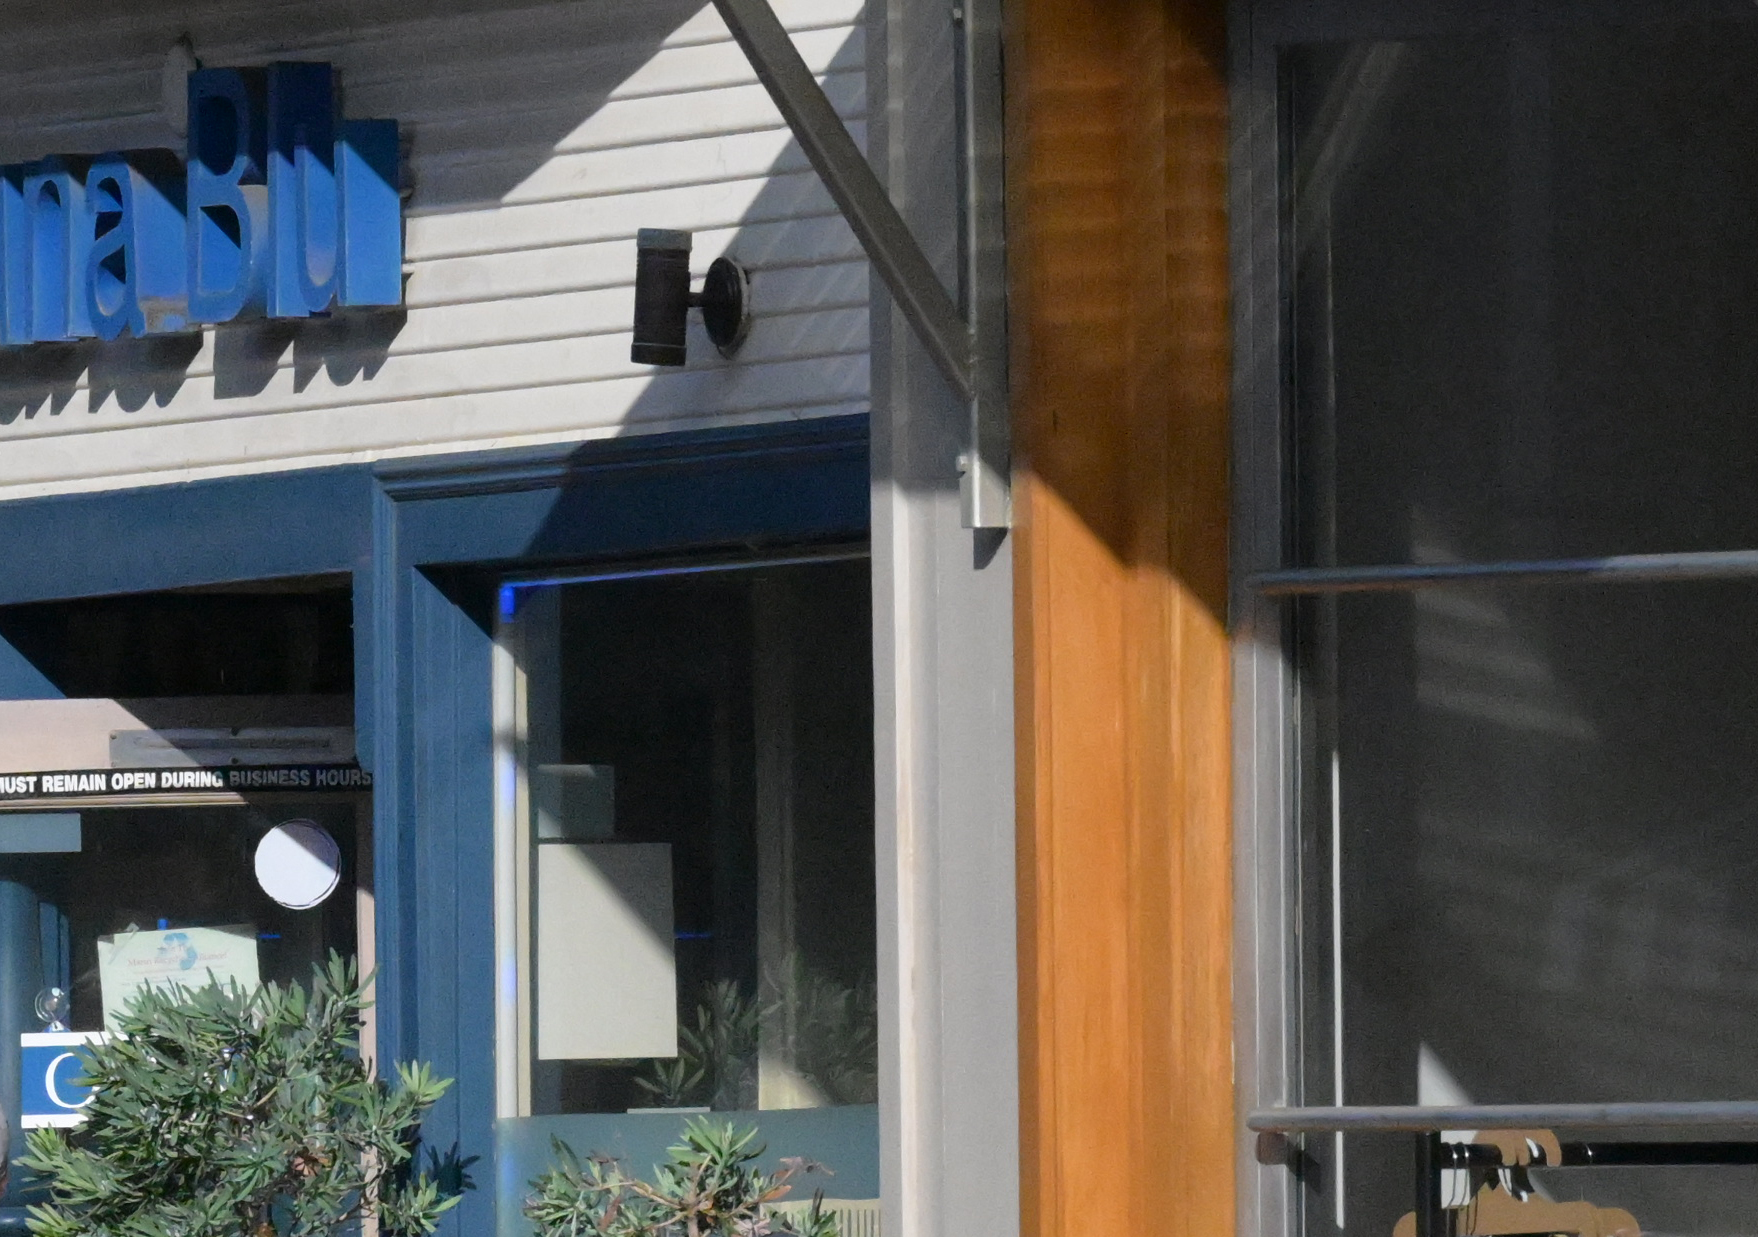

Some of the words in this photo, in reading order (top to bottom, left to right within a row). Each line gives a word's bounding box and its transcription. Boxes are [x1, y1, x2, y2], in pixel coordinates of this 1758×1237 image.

[41, 773, 106, 792] REMAIN
[111, 771, 156, 790] OPEN
[160, 770, 224, 789] DURING
[229, 768, 310, 788] BUSINESS
[315, 767, 372, 786] HOURS
